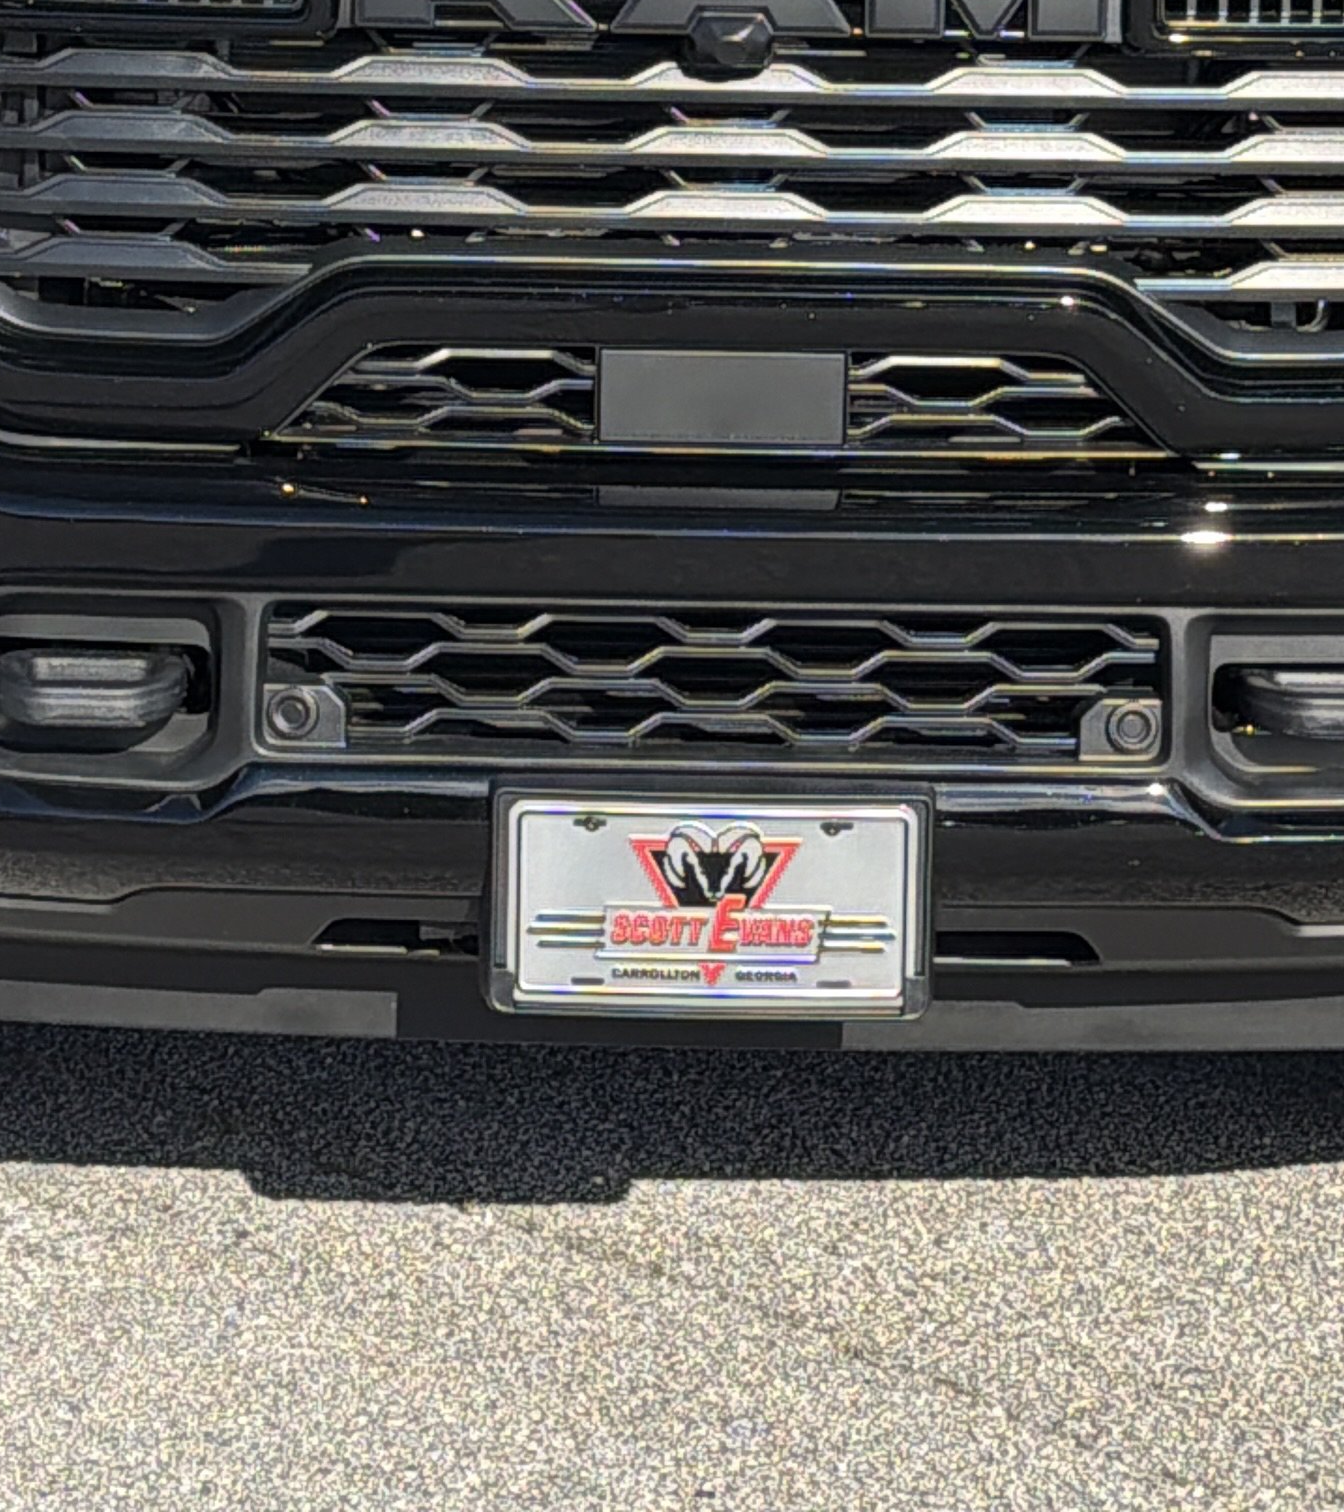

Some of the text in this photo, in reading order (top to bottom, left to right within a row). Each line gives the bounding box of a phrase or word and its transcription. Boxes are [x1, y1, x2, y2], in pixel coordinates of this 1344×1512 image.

[611, 910, 709, 946] SCOTT
[611, 967, 798, 984] CARROLLTON GEORGIA
